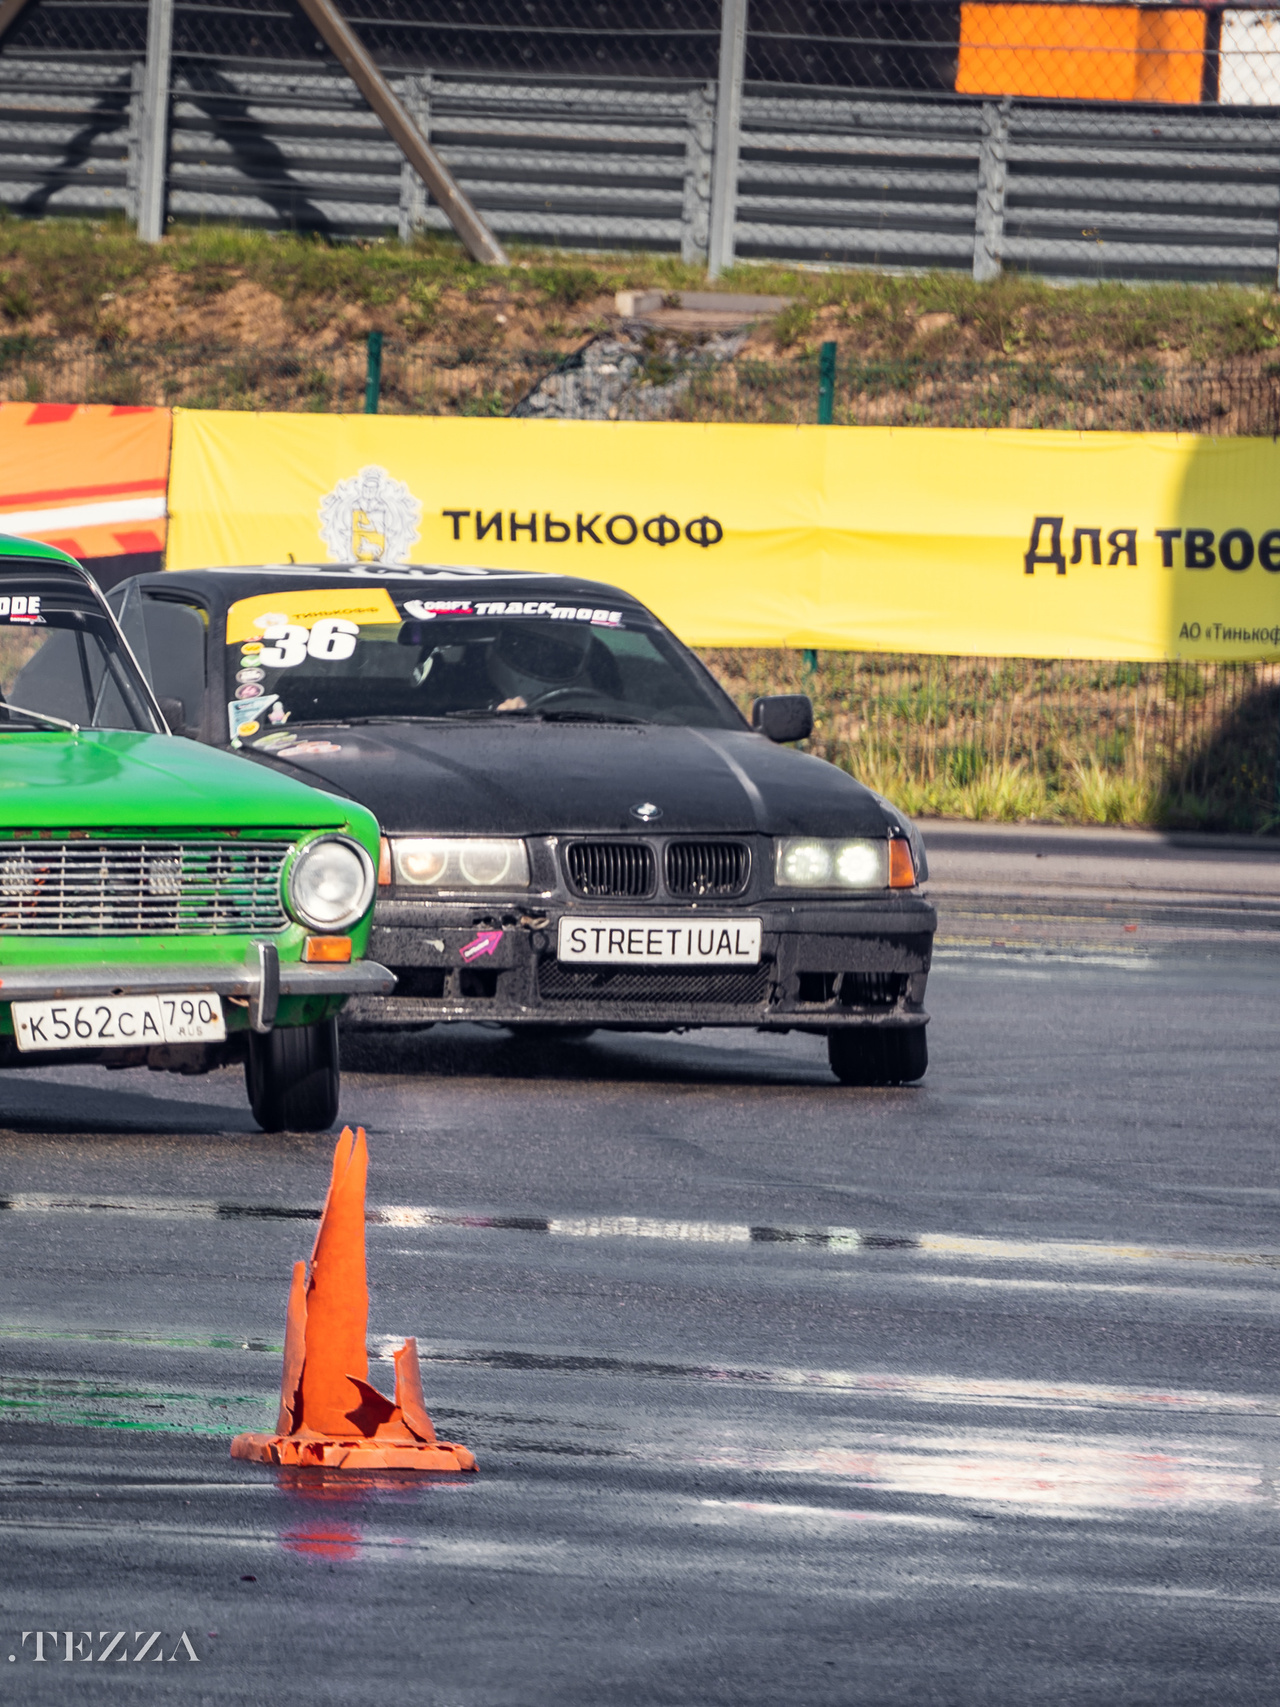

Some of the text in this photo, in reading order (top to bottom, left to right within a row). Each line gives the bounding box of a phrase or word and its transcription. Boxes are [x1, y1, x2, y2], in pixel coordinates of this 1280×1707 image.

[442, 510, 724, 548] ТИНЬКОФФ
[1024, 515, 1280, 575] Для твое
[292, 607, 379, 620] ТИНЬКОФФ
[474, 601, 556, 616] TRACK
[1179, 621, 1202, 639] АО
[259, 617, 360, 668] 36
[163, 999, 212, 1026] 790
[177, 1026, 203, 1036] RUS
